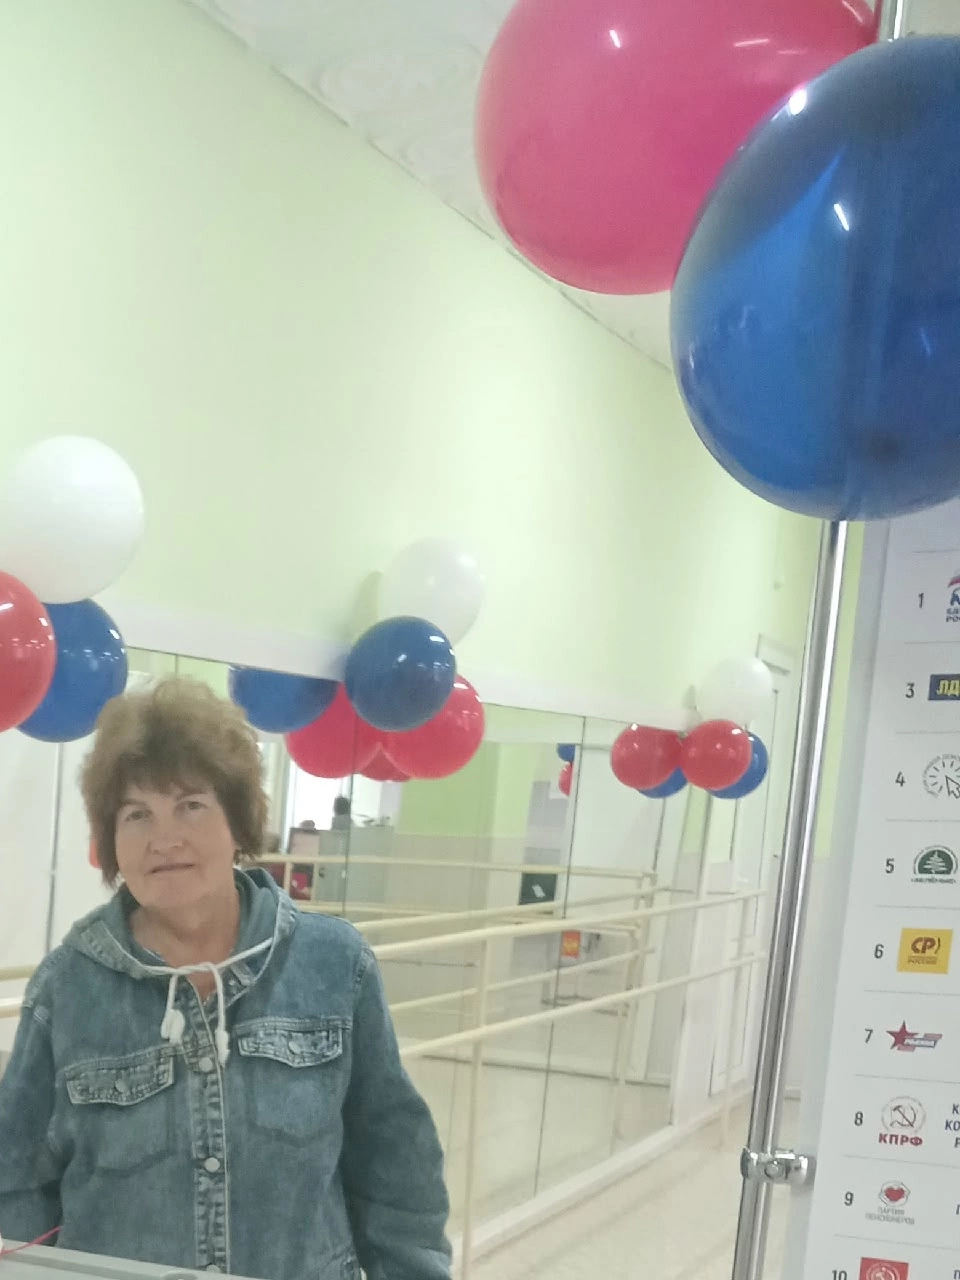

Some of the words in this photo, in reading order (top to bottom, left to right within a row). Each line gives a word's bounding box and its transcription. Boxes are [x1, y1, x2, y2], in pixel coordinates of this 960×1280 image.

[918, 592, 925, 609] 1
[905, 682, 915, 699] 3
[936, 680, 960, 697] ЛД
[895, 771, 906, 787] 4
[885, 858, 895, 874] 5
[873, 943, 884, 959] 6
[864, 1028, 874, 1044] 7
[854, 1111, 864, 1127] 8
[878, 1132, 923, 1147] КПРФ
[844, 1191, 854, 1207] 9
